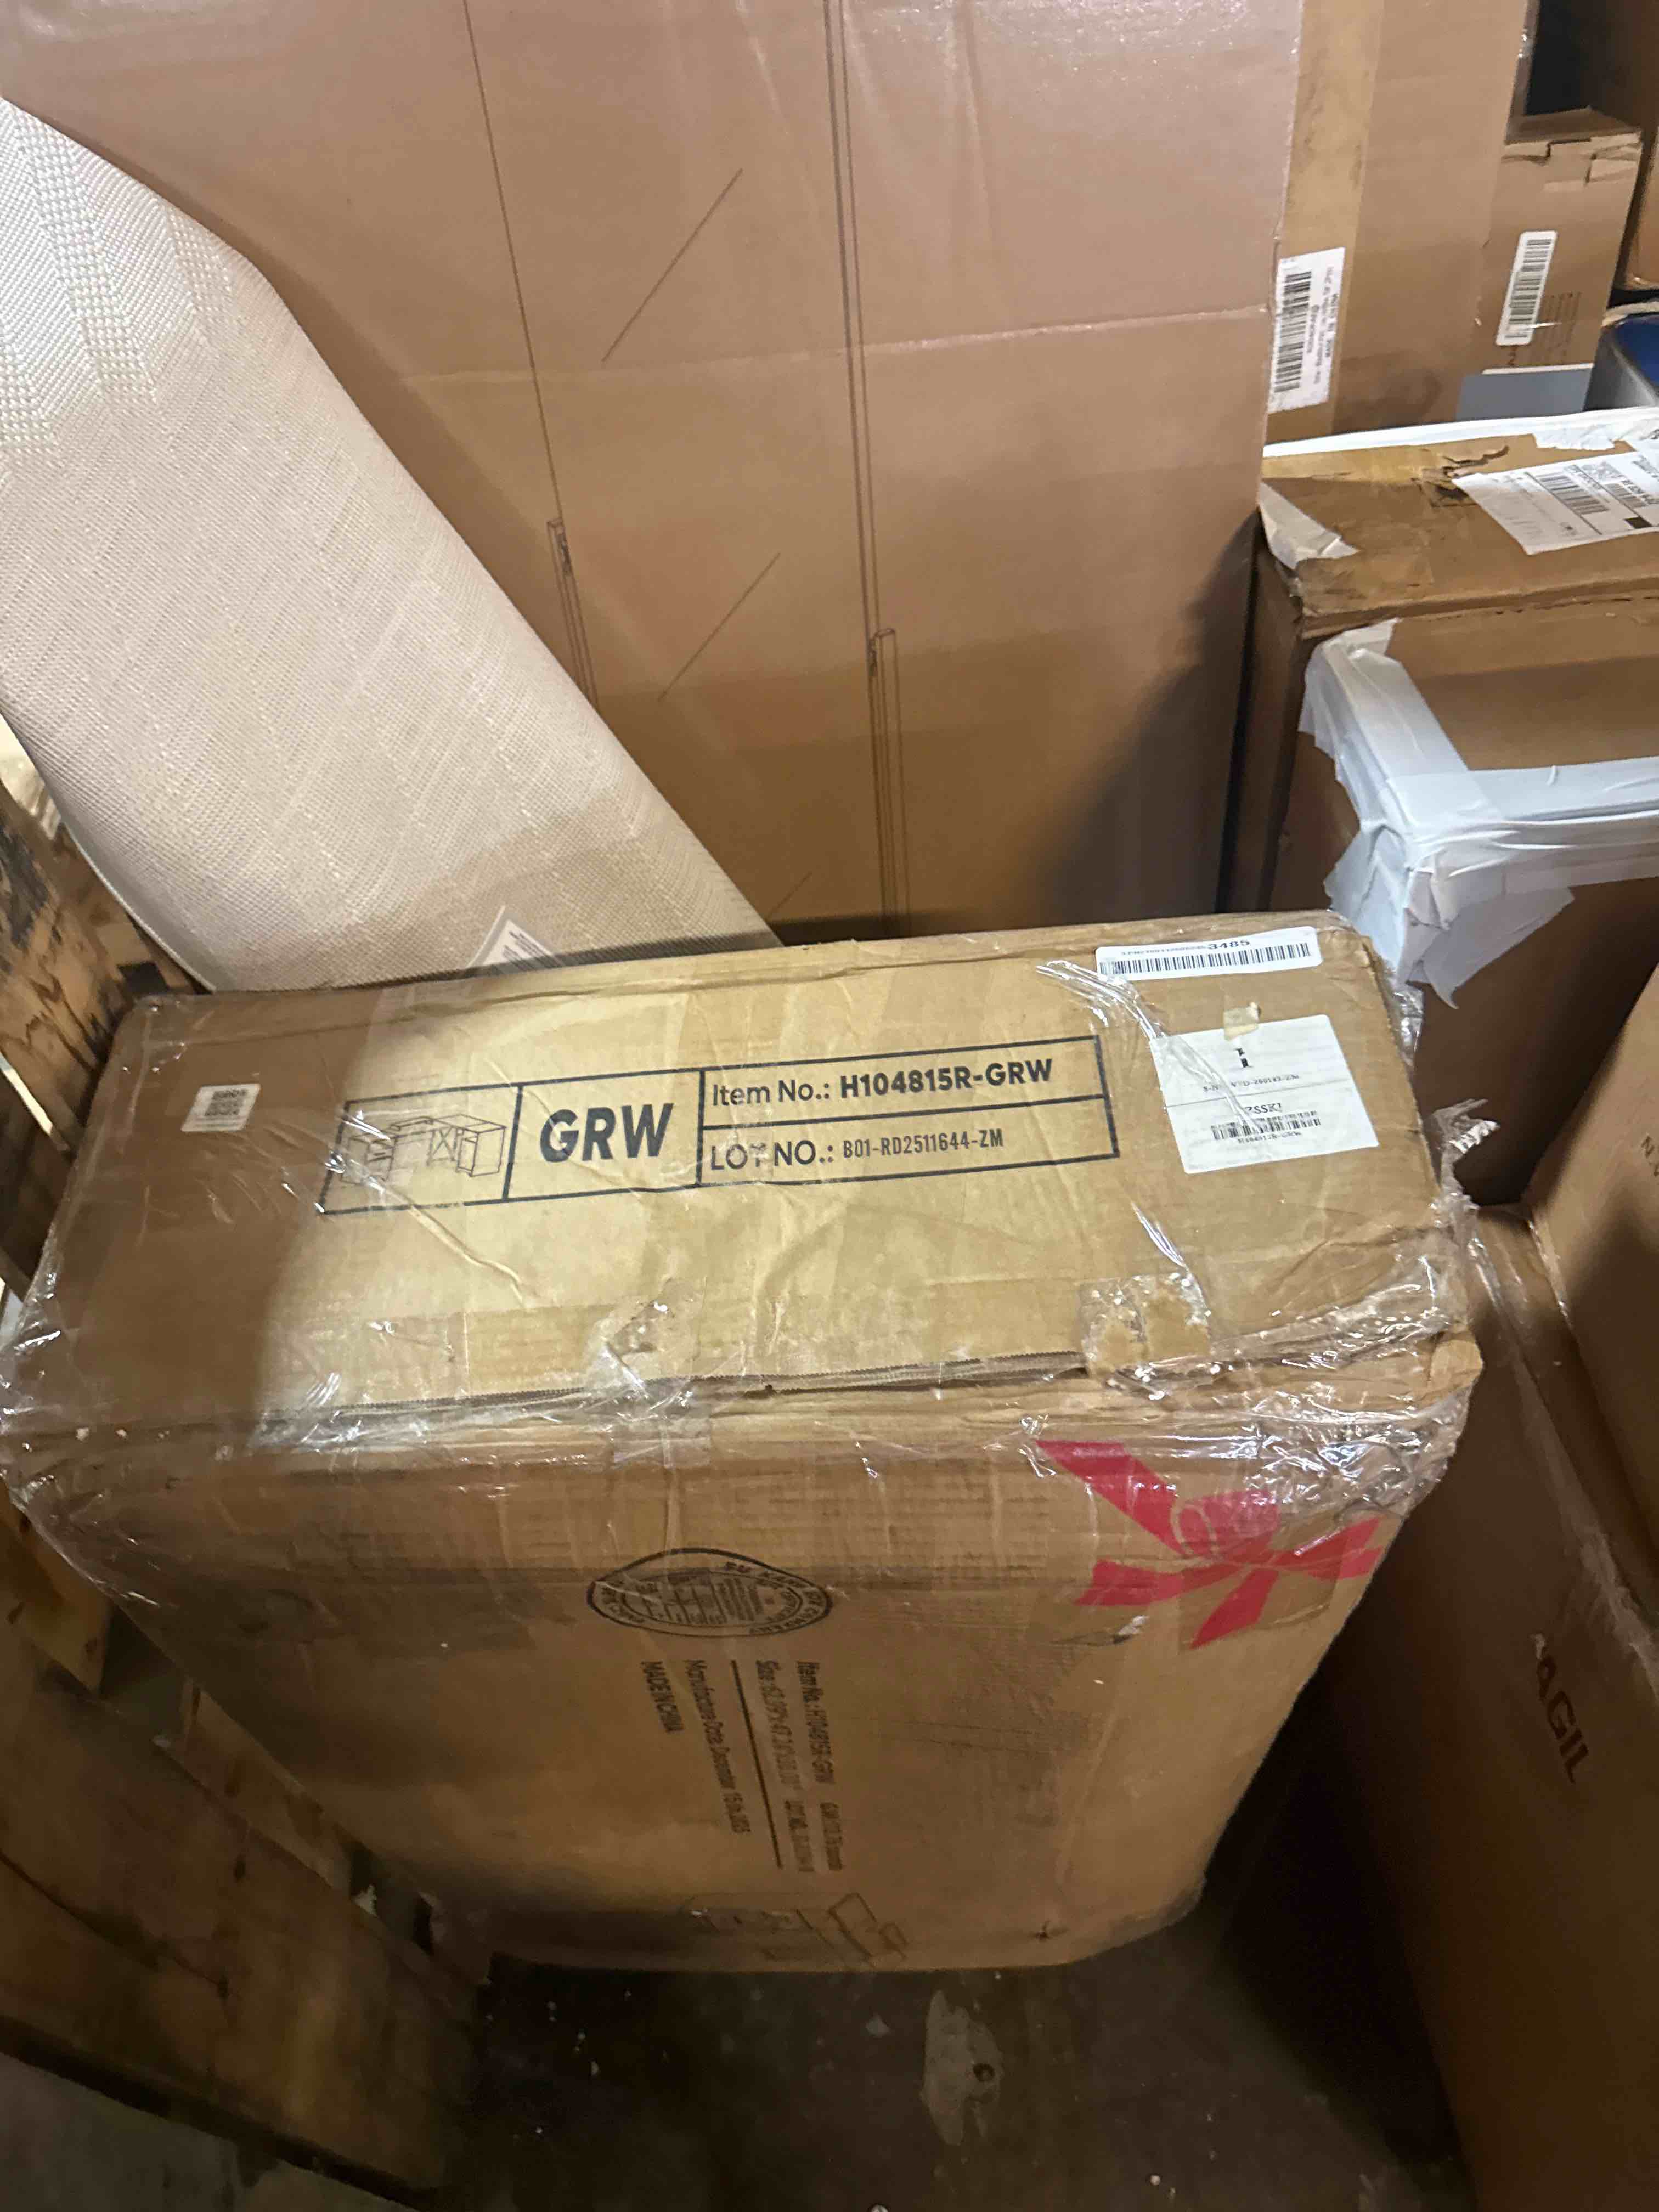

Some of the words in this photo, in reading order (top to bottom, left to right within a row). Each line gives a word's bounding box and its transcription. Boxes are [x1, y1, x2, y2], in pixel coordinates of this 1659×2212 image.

[713, 1084, 770, 1107] Item
[778, 1079, 830, 1102] No.:
[840, 1058, 1053, 1098] H104815R-GRW
[540, 1103, 675, 1163] GRW
[710, 1142, 766, 1170] LOT
[774, 1139, 833, 1167] NO.:
[843, 1128, 1004, 1159] B01-RD2511644-ZM
